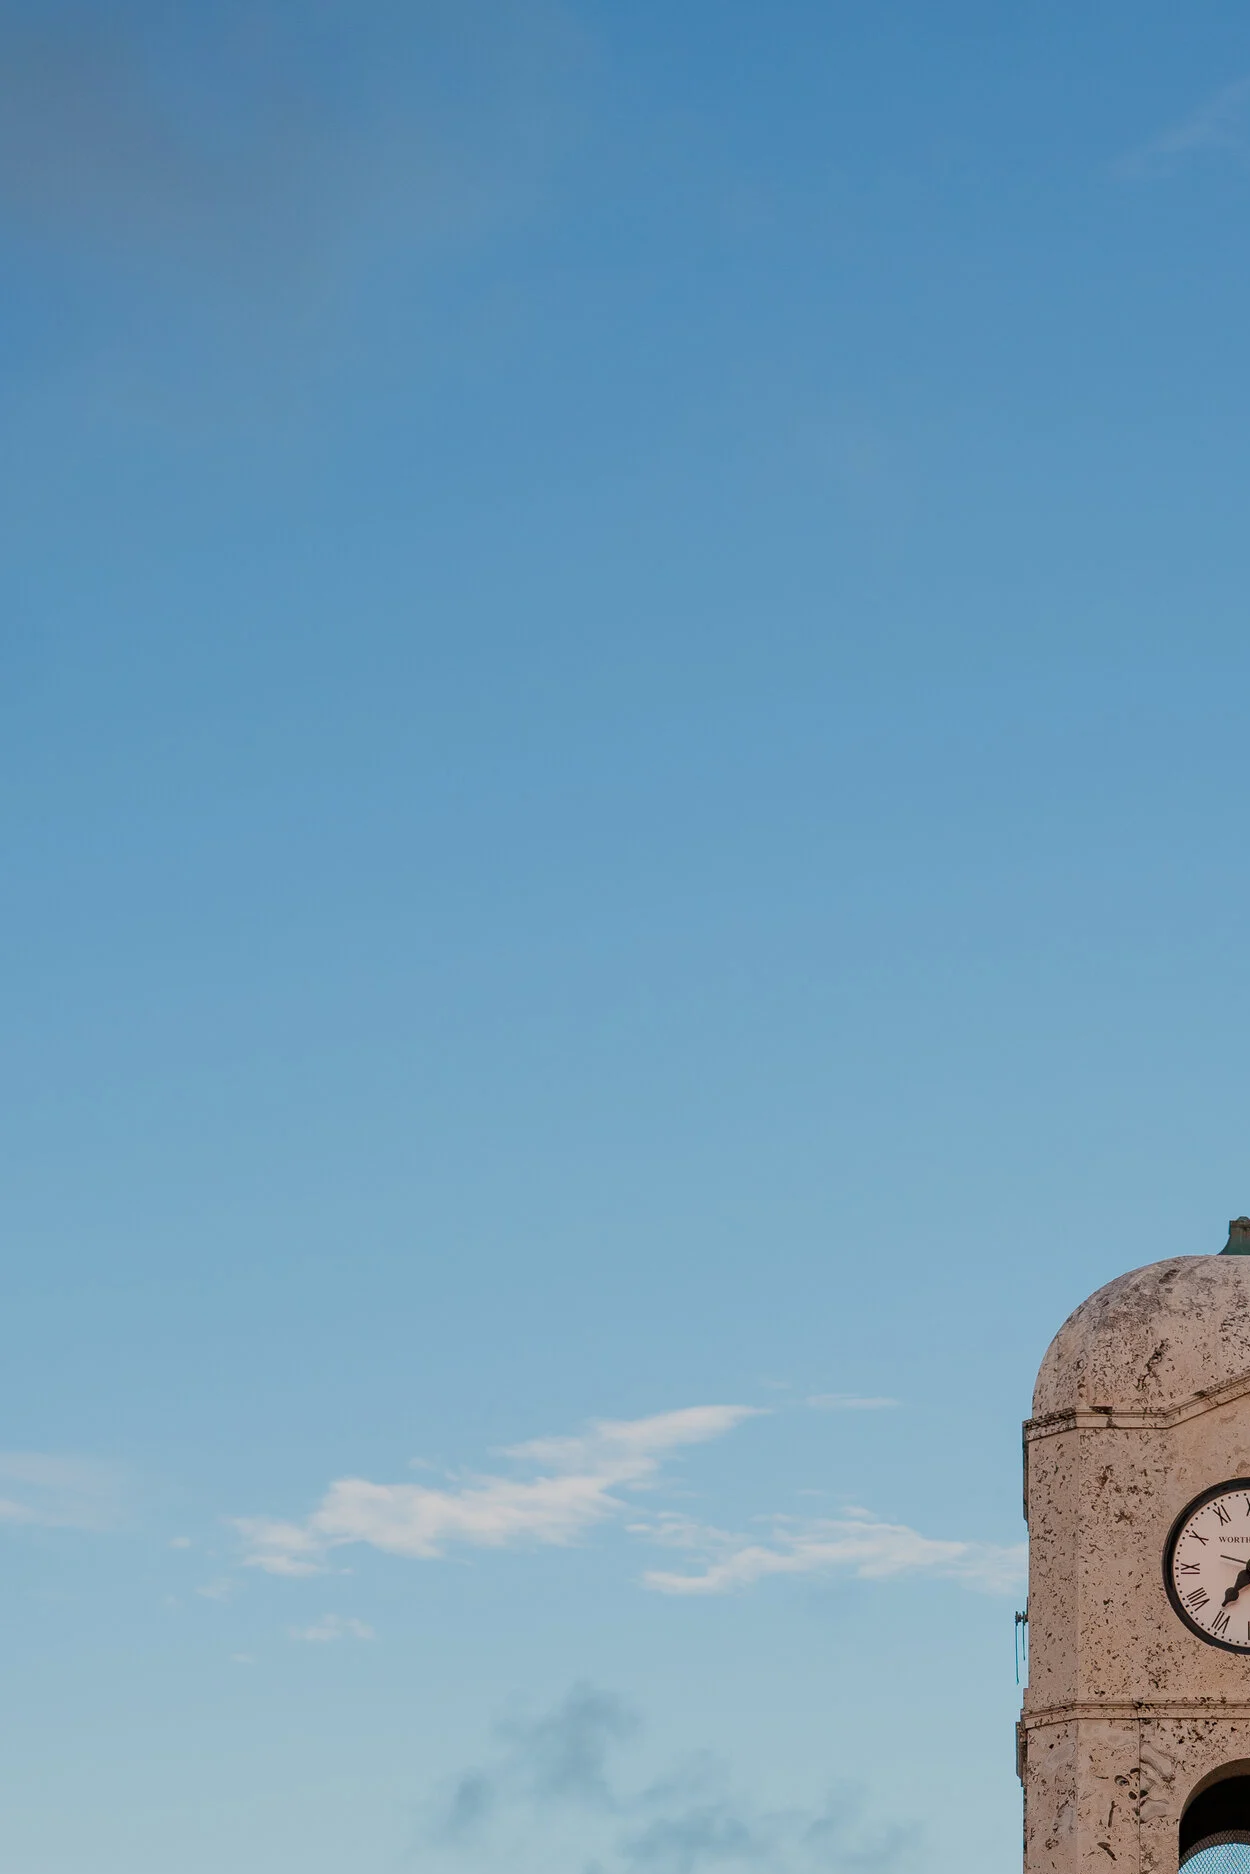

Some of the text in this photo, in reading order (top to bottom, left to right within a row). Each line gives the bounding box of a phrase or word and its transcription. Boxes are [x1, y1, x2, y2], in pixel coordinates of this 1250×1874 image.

[1213, 1504, 1232, 1526] XI
[1189, 1530, 1209, 1545] X
[1181, 1563, 1200, 1574] IX
[1187, 1587, 1210, 1611] VIII
[1211, 1611, 1230, 1633] VII
